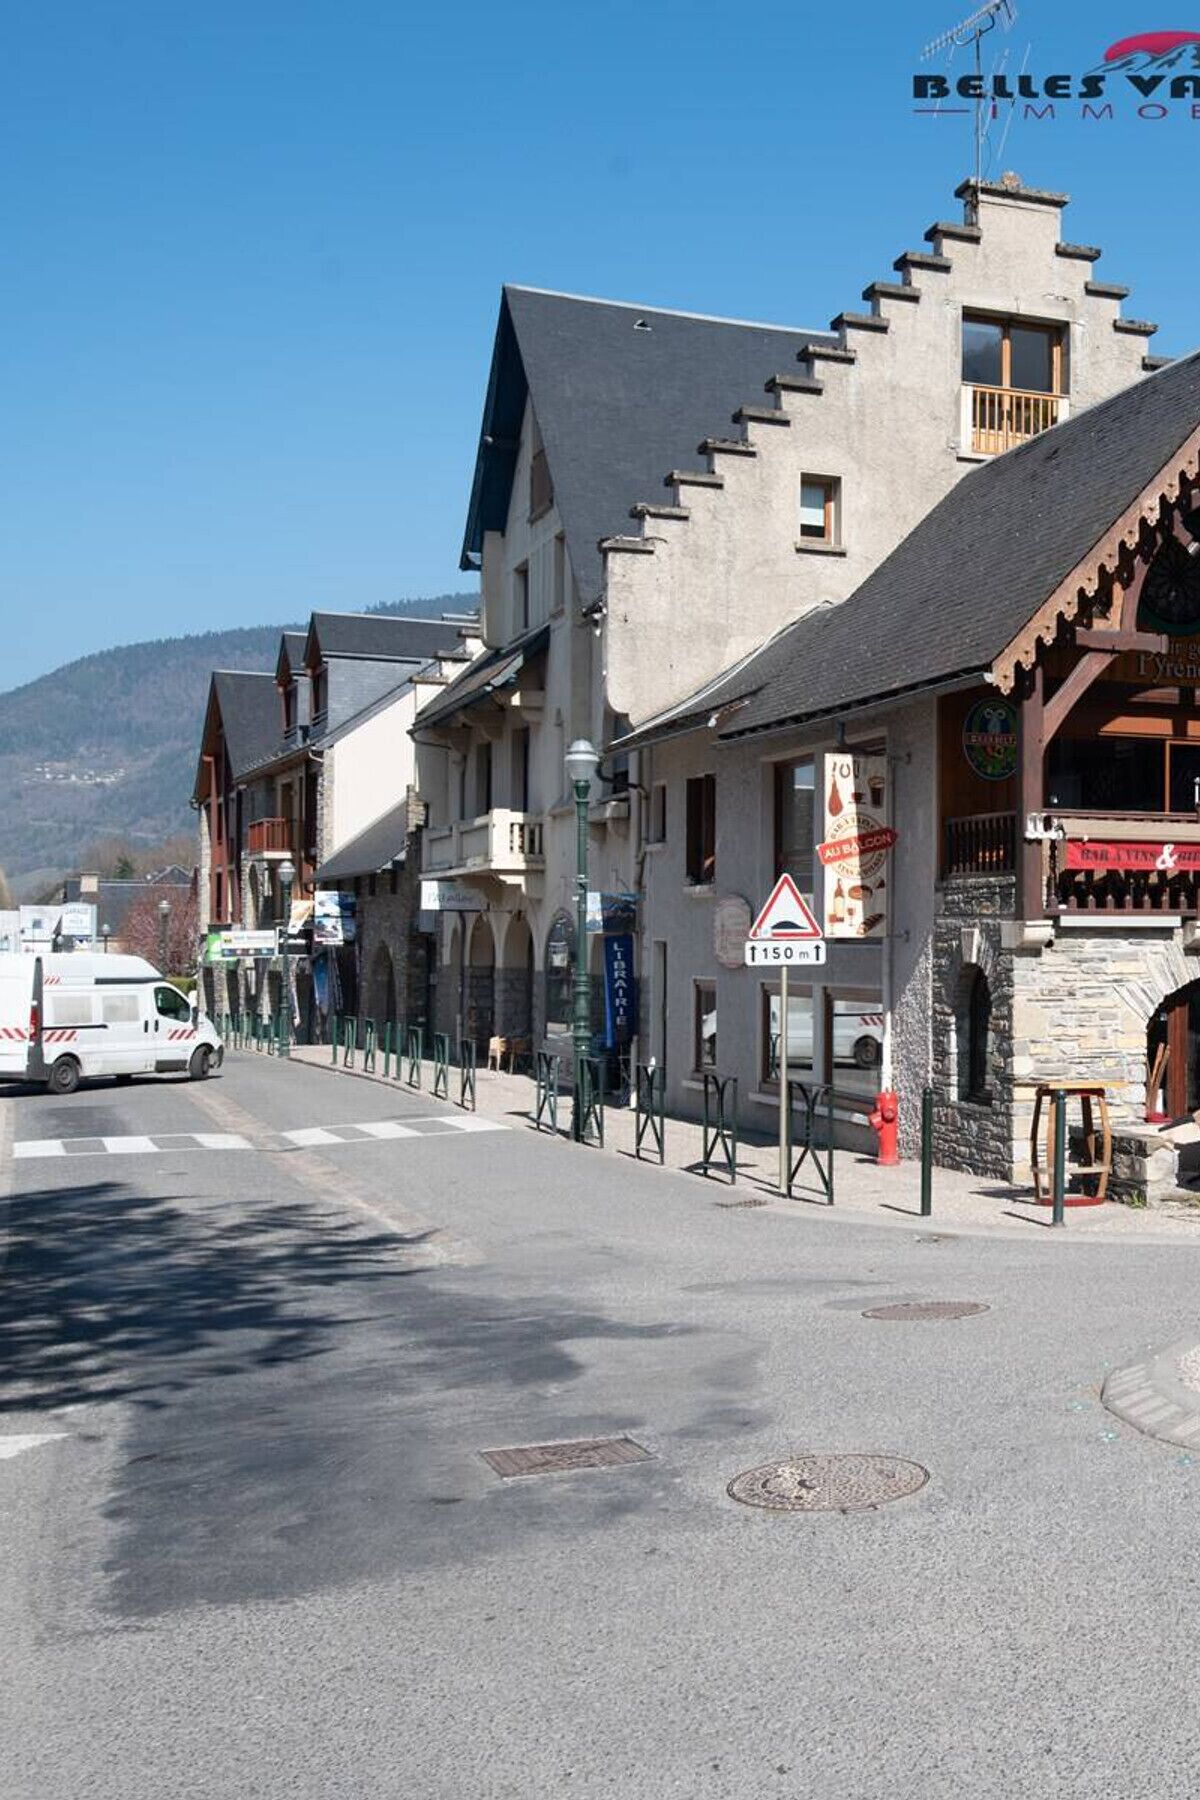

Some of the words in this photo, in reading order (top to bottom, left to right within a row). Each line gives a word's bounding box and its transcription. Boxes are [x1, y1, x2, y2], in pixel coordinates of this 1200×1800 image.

[824, 846, 841, 859] AU
[843, 832, 893, 855] BALCON
[1155, 844, 1178, 869] &
[762, 946, 794, 960] 150
[799, 950, 809, 959] m
[613, 941, 628, 1026] LIBRAIRIE
